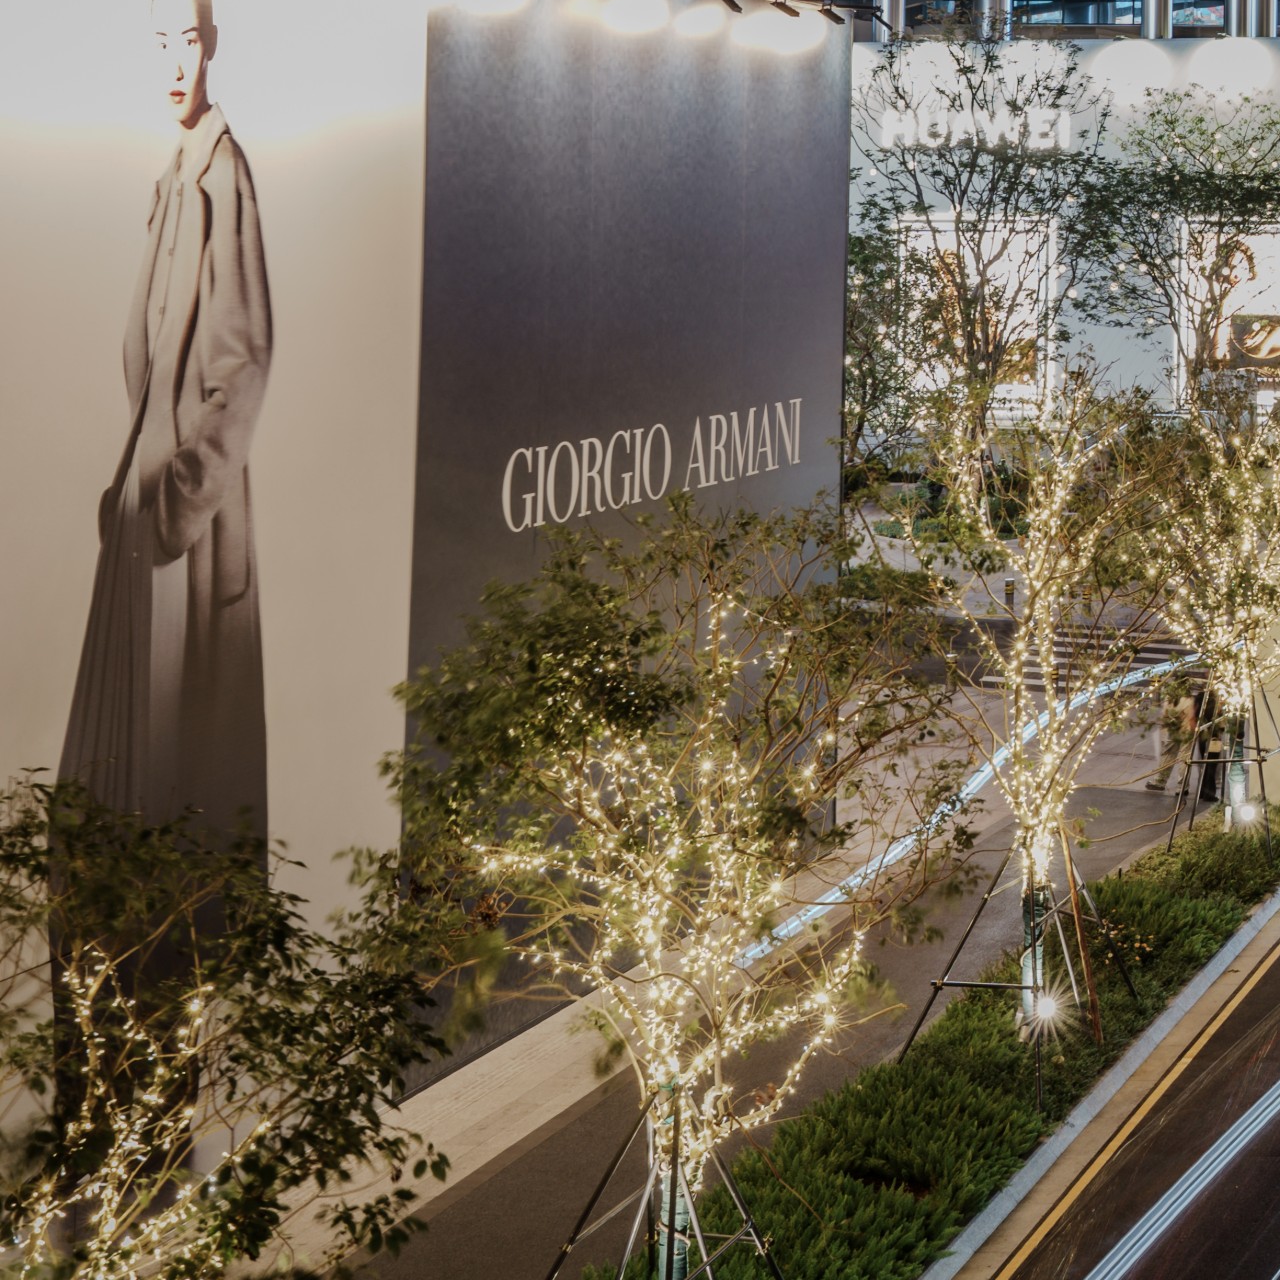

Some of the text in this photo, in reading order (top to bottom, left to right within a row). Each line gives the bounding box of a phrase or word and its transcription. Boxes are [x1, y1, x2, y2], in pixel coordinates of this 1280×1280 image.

[881, 106, 1072, 150] HUAWEI
[501, 398, 802, 533] GIORGIO ARMANI
